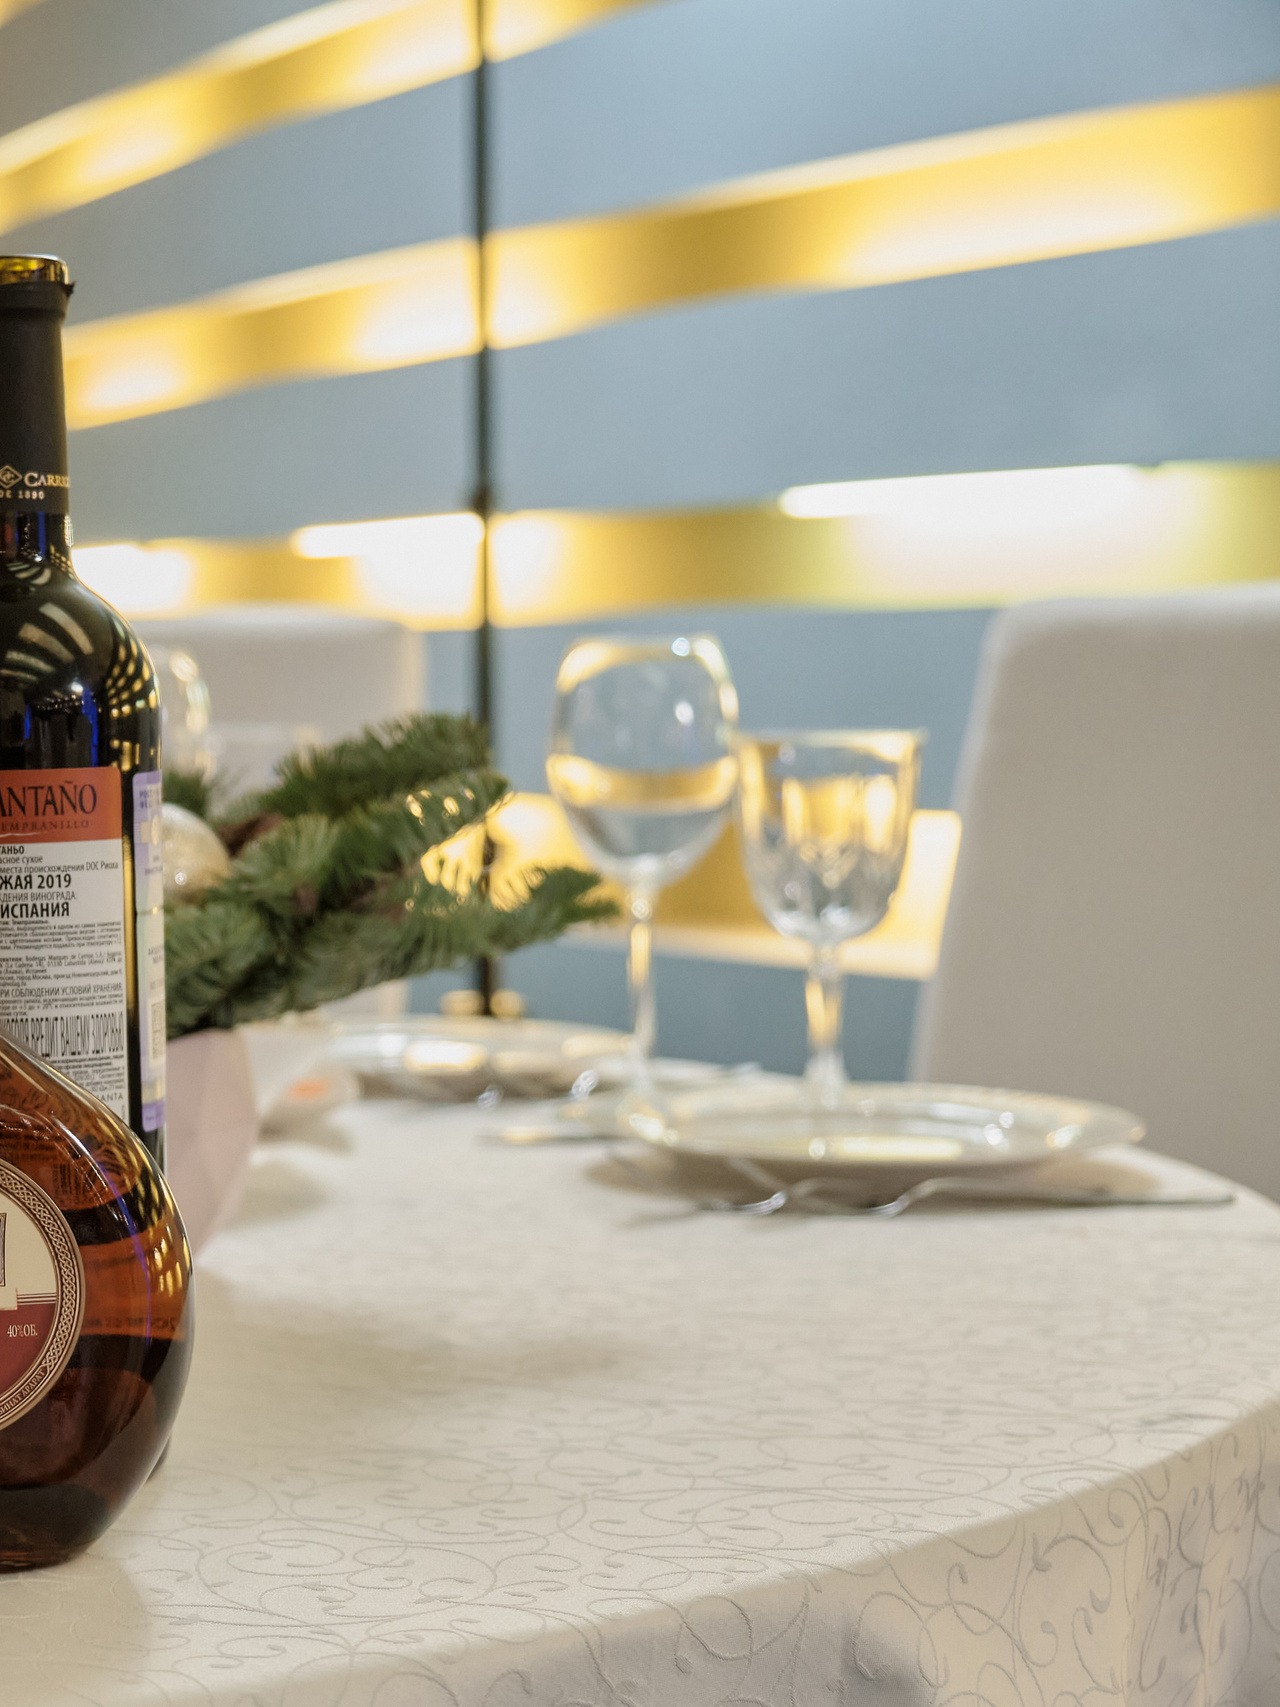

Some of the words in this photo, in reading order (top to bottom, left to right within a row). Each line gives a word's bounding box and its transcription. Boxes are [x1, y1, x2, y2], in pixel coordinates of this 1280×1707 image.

[0, 866, 22, 875] места
[24, 862, 85, 876] происхождения
[21, 855, 44, 867] сухое
[37, 872, 72, 890] 2019
[0, 900, 71, 919] ИСПАНИЯ
[10, 986, 60, 998] СОБЛЮДЕНИИ
[61, 983, 92, 996] УСЛОВИЙ
[22, 1369, 47, 1398] АРАРАТ
